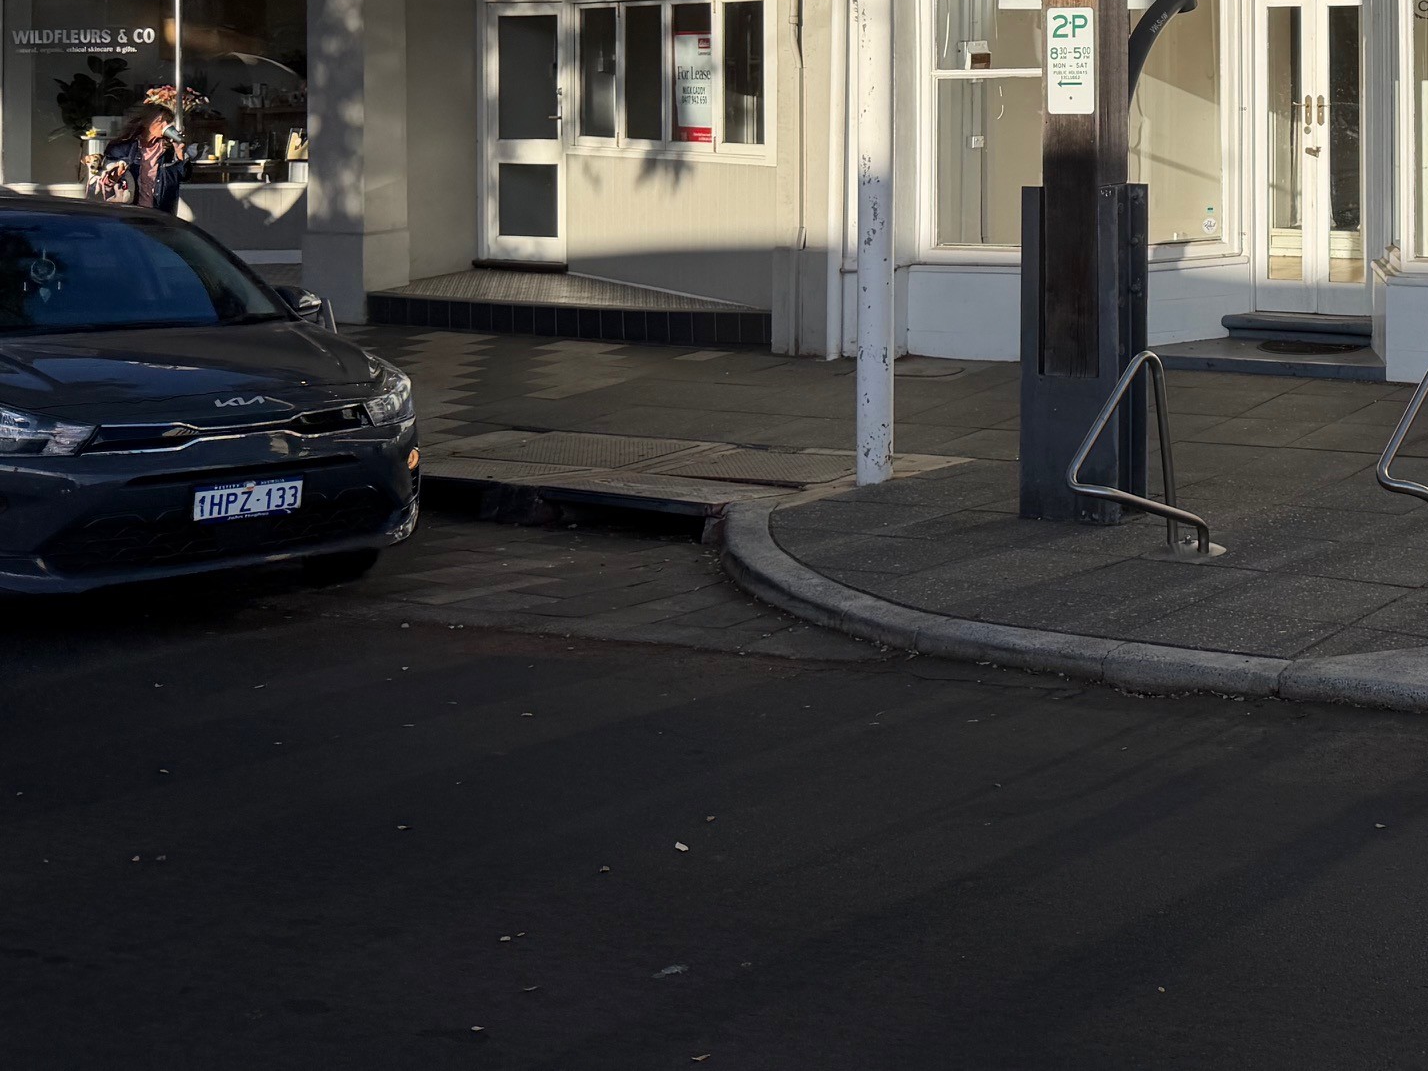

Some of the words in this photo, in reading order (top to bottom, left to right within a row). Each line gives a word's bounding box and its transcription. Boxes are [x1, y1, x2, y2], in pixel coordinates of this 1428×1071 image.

[1052, 14, 1088, 38] 2P
[12, 29, 112, 45] WILDFLEURS
[117, 29, 128, 44] &
[133, 27, 156, 44] CO
[677, 65, 690, 80] For
[691, 66, 711, 81] Lease
